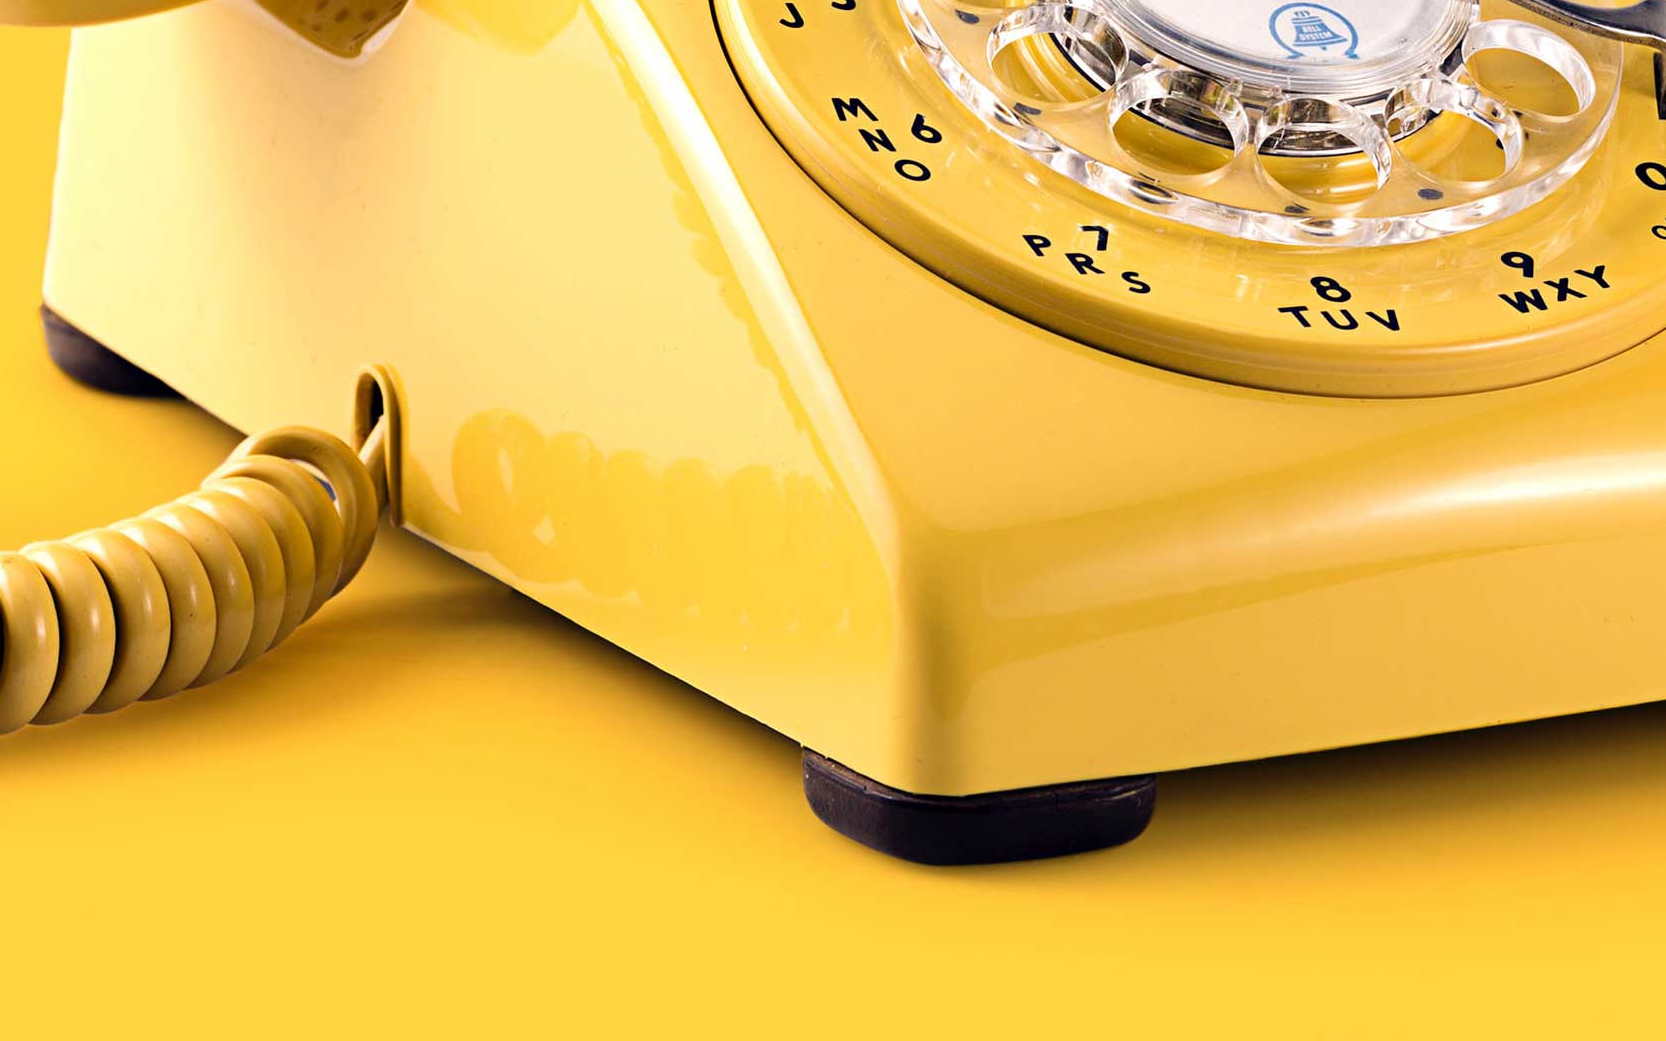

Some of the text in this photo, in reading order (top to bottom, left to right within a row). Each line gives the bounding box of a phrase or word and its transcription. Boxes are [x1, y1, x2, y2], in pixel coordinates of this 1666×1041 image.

[1299, 31, 1333, 41] SYSTEM
[832, 98, 931, 181] MNO
[911, 114, 942, 143] 6
[1082, 226, 1108, 251] 7
[1023, 235, 1150, 293] PRS
[1501, 252, 1534, 278] 9
[1310, 277, 1351, 302] 8
[1499, 266, 1610, 313] WXY
[1278, 306, 1399, 331] TUV
